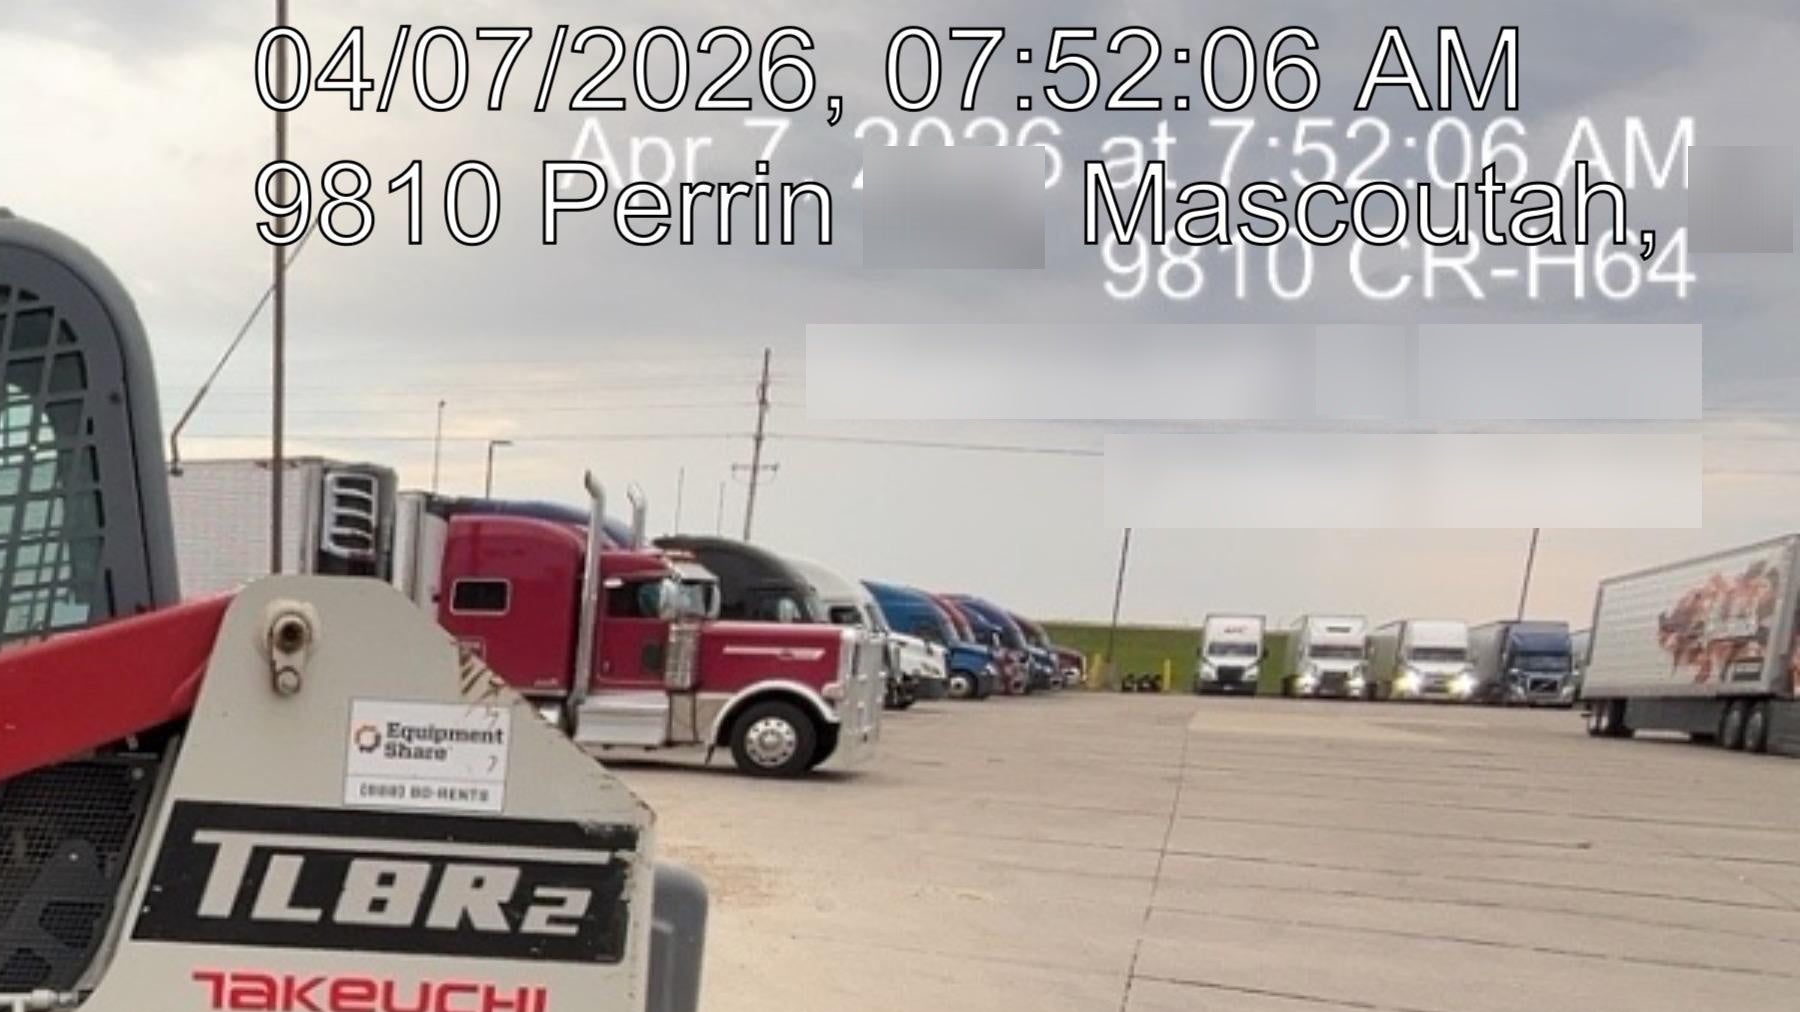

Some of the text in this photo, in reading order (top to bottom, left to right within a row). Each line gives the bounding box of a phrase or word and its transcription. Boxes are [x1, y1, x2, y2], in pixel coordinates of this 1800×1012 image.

[385, 722, 504, 746] Equipment
[383, 741, 449, 762] Share
[193, 829, 612, 937] TL8R2
